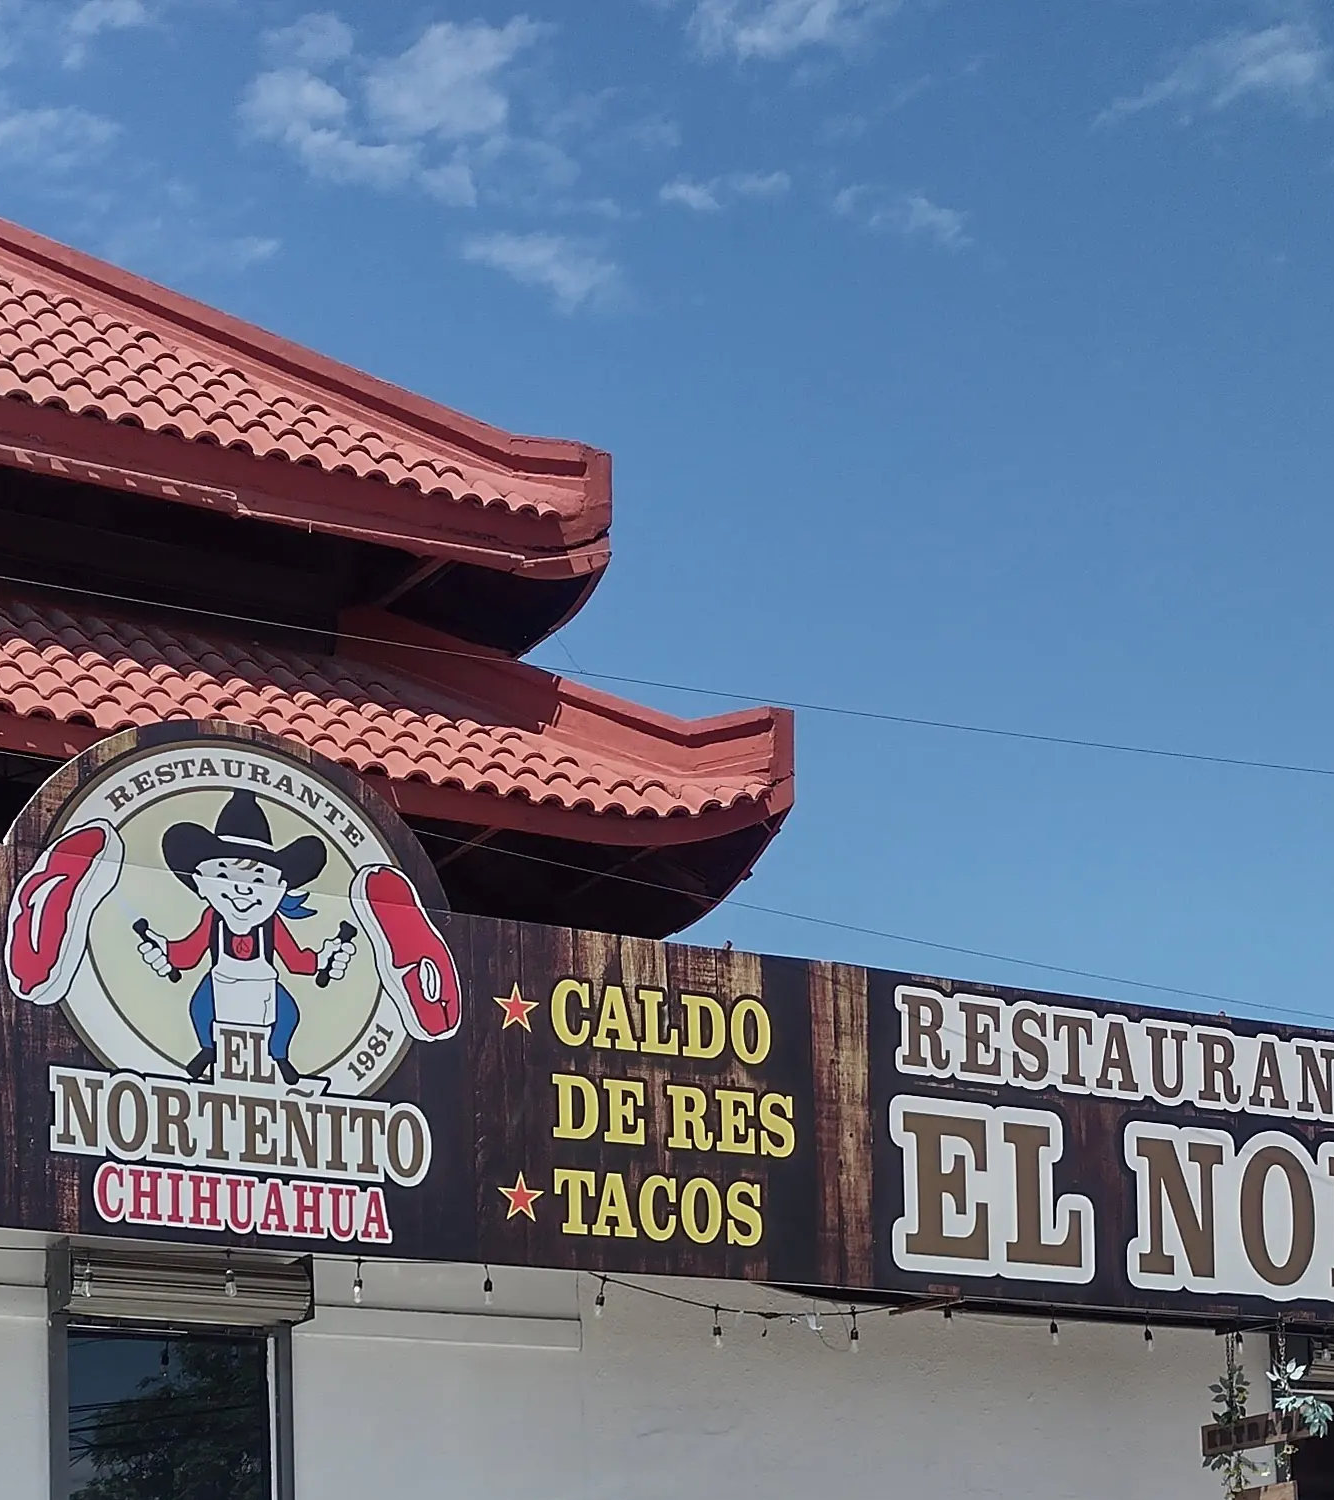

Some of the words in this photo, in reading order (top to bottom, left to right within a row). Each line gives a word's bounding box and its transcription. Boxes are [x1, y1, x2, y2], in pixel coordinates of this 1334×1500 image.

[104, 757, 365, 849] RESTAURANTE
[219, 1027, 277, 1085] EL
[347, 1023, 395, 1082] 1981
[551, 978, 771, 1065] CALDO
[56, 1074, 424, 1178] NORTEÑITO
[553, 1073, 647, 1147] DE
[667, 1083, 795, 1158] RES
[97, 1165, 390, 1240] CHIHUAHUA
[554, 1168, 764, 1247] TACOS
[902, 1111, 1084, 1269] EL
